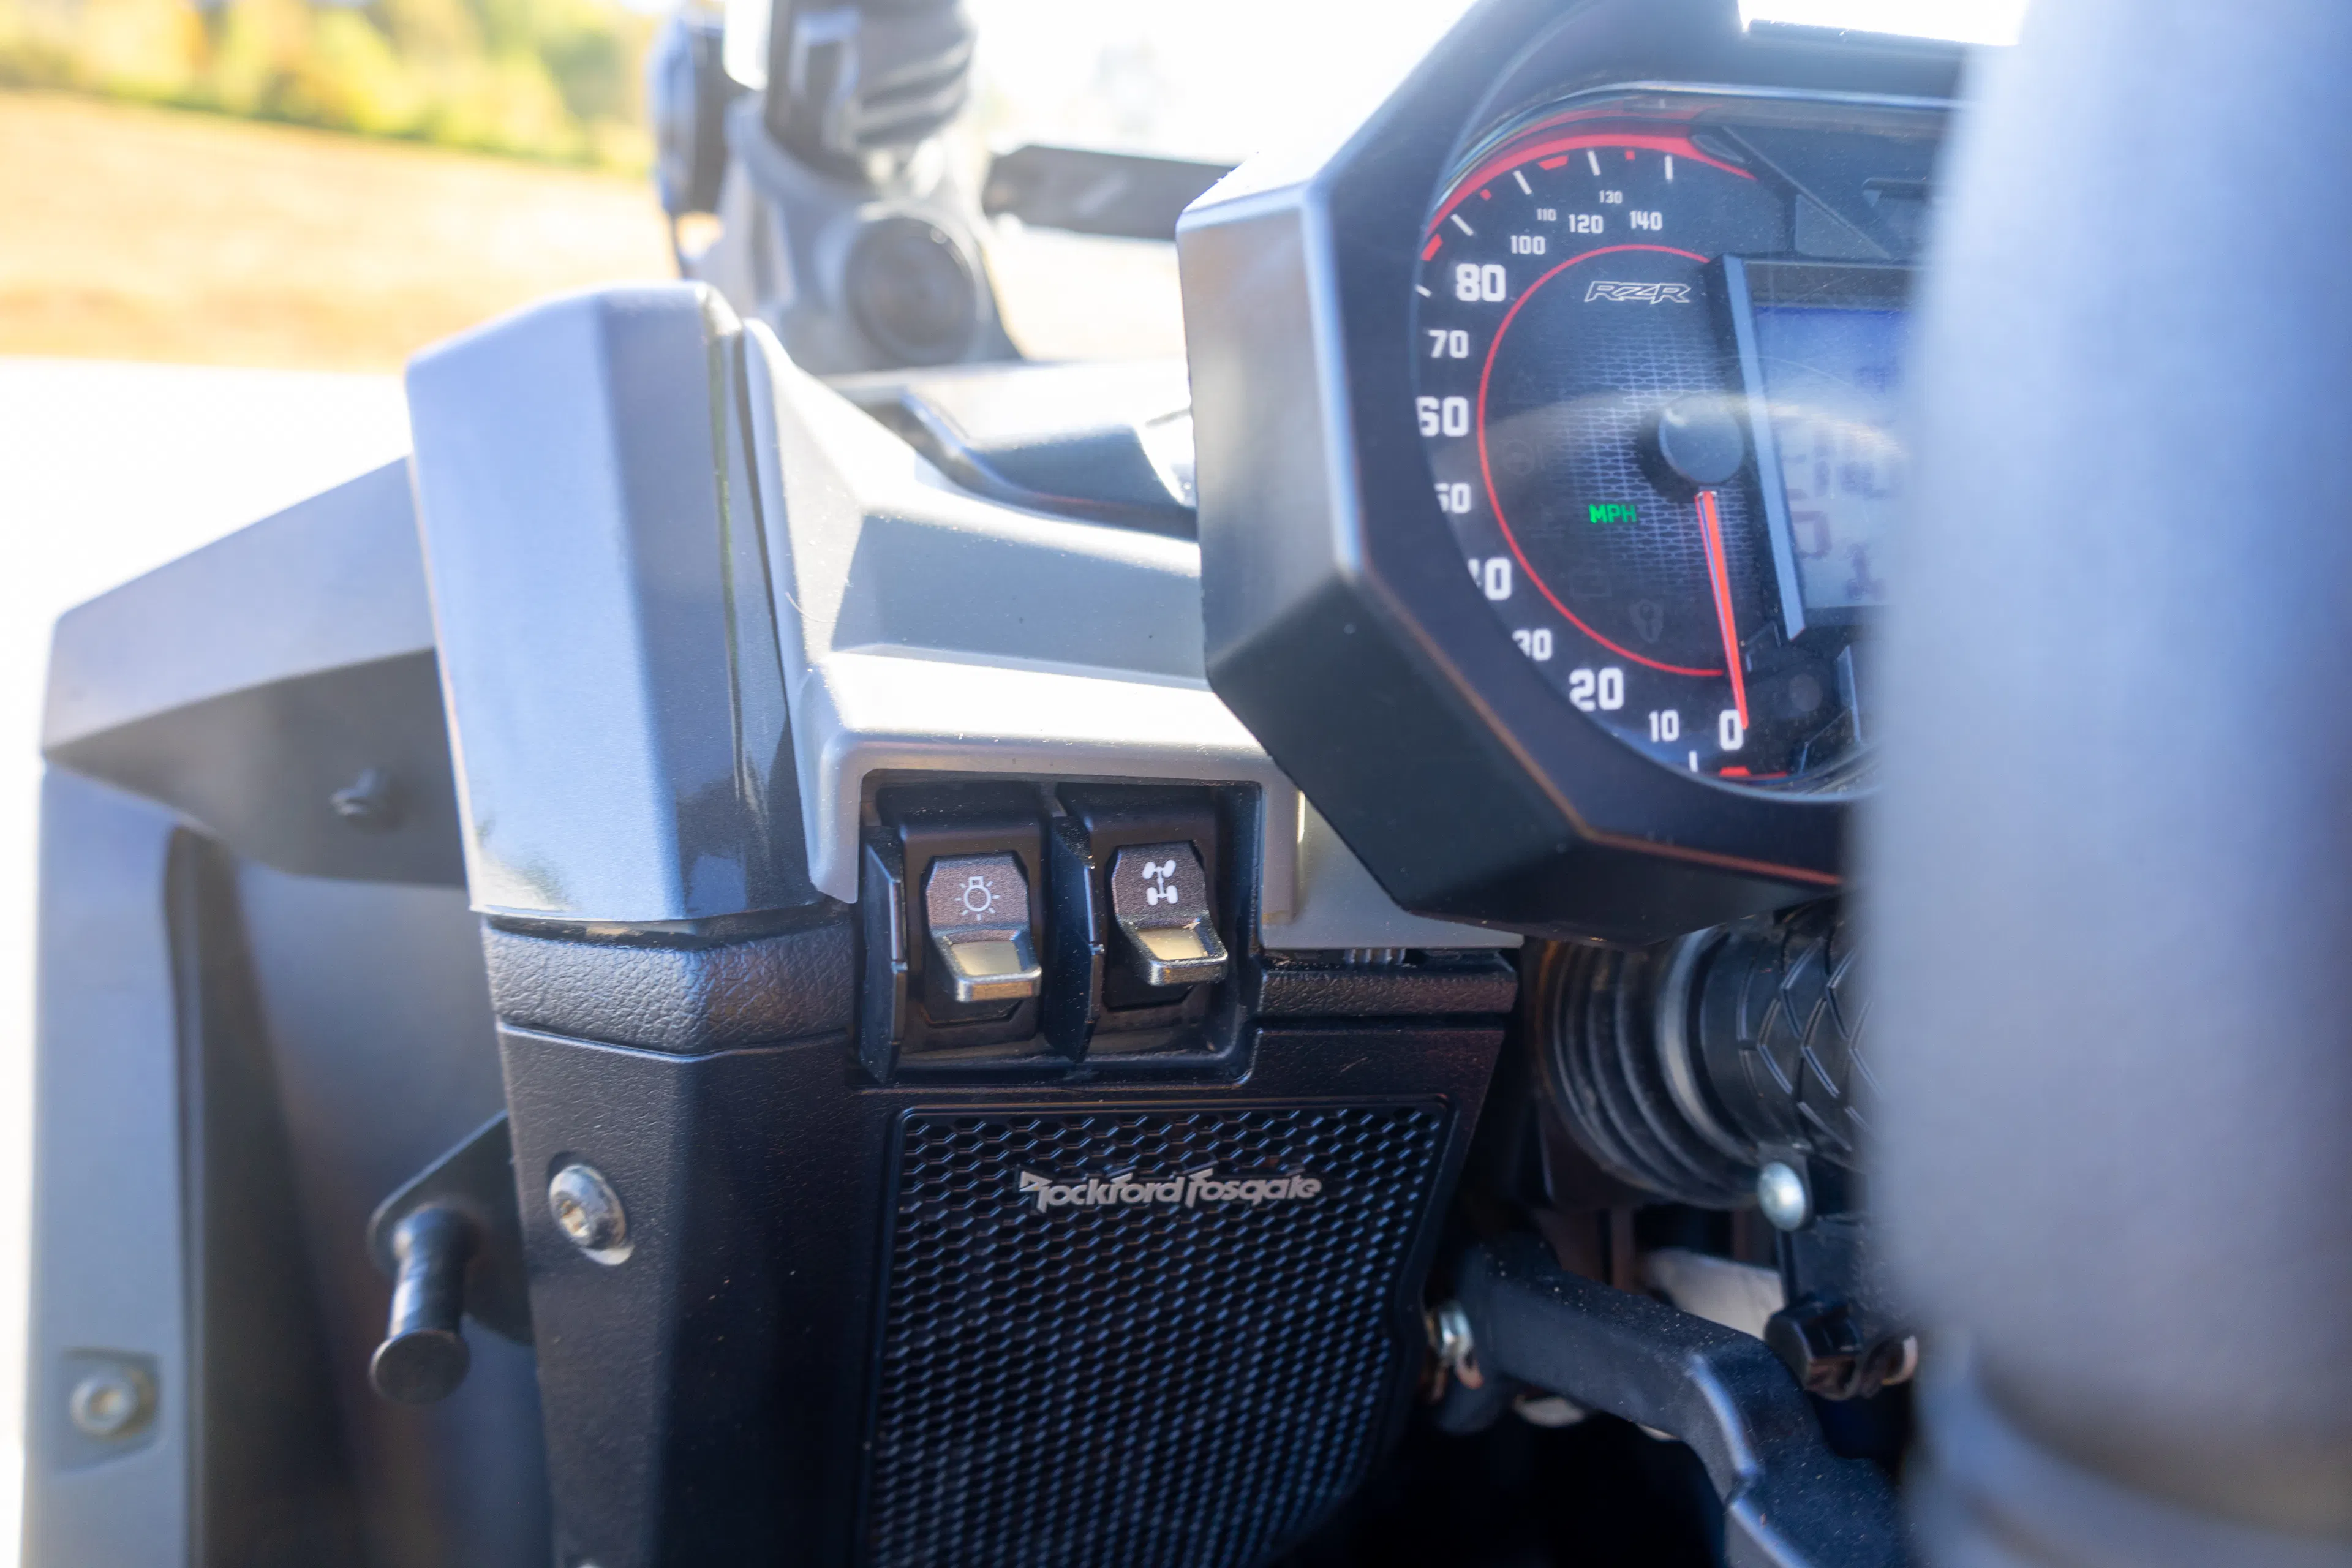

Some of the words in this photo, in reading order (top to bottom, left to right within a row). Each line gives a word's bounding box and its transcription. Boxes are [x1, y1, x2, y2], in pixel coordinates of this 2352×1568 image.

[1599, 190, 1623, 204] 130
[1537, 208, 1557, 222] 110
[1569, 214, 1604, 234] 120
[1629, 210, 1663, 231] 140
[1510, 235, 1546, 255] 100
[1455, 263, 1506, 302] 80
[1583, 280, 1692, 305] RZR
[1428, 329, 1469, 359] 70
[1589, 503, 1637, 523] MPH
[1468, 557, 1512, 601] 0
[1569, 667, 1624, 712] 20
[1649, 709, 1679, 743] 10
[1719, 709, 1744, 751] 0
[1020, 1170, 1185, 1213] Rockford
